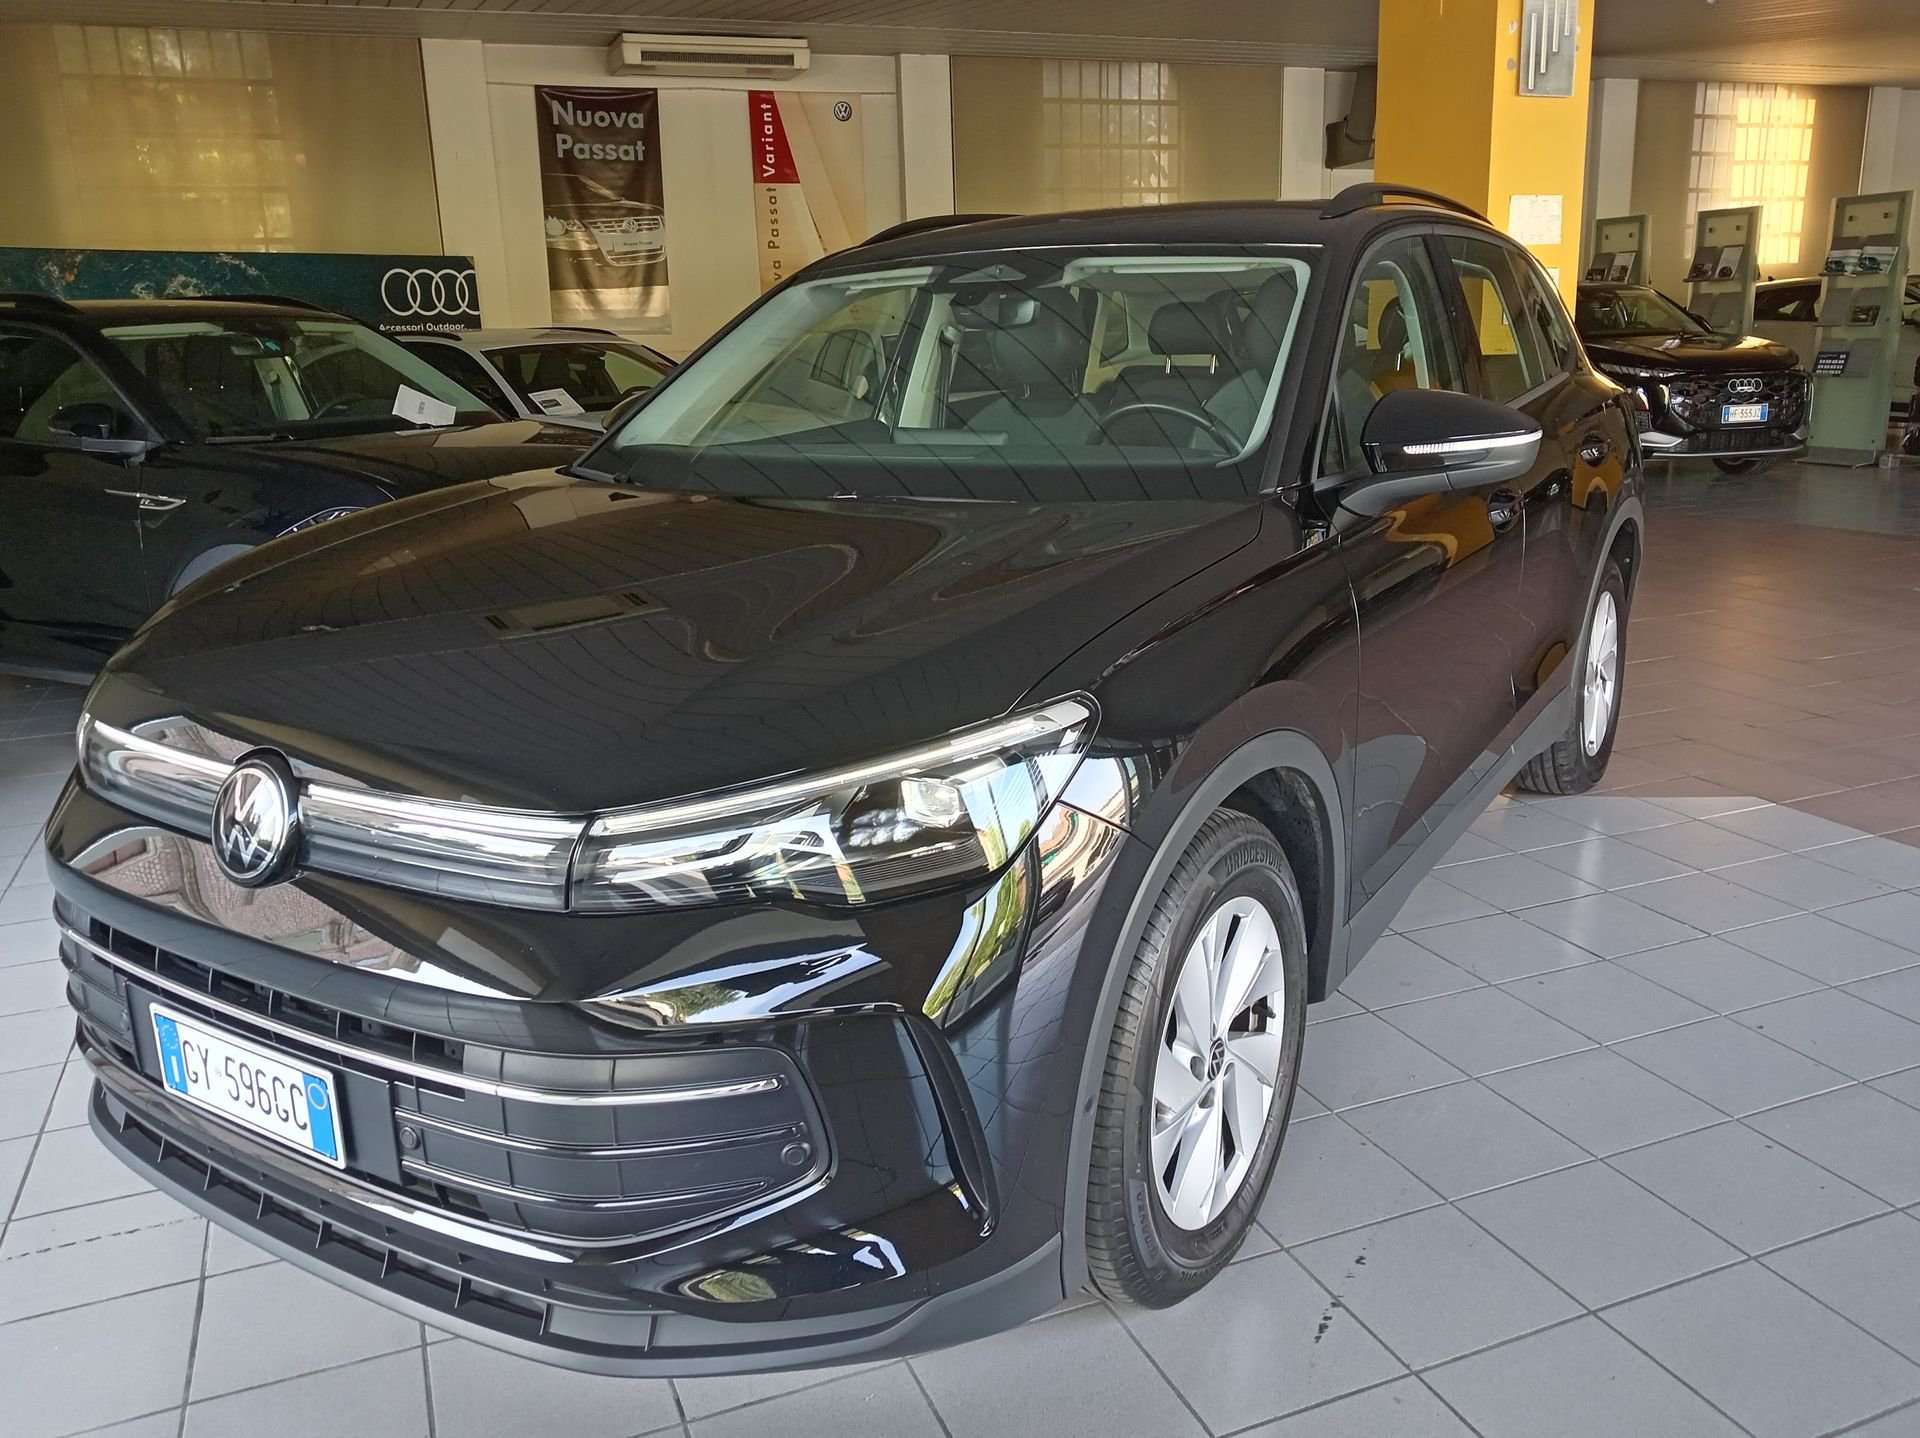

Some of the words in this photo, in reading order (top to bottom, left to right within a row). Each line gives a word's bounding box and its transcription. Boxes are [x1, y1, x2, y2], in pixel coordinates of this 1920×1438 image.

[551, 99, 644, 129] Nuova
[556, 133, 645, 160] Passat
[761, 103, 776, 177] Variant
[766, 187, 781, 250] Passat
[426, 322, 464, 332] Outdoor
[183, 1039, 211, 1090] GY
[224, 1055, 308, 1131] 596GC
